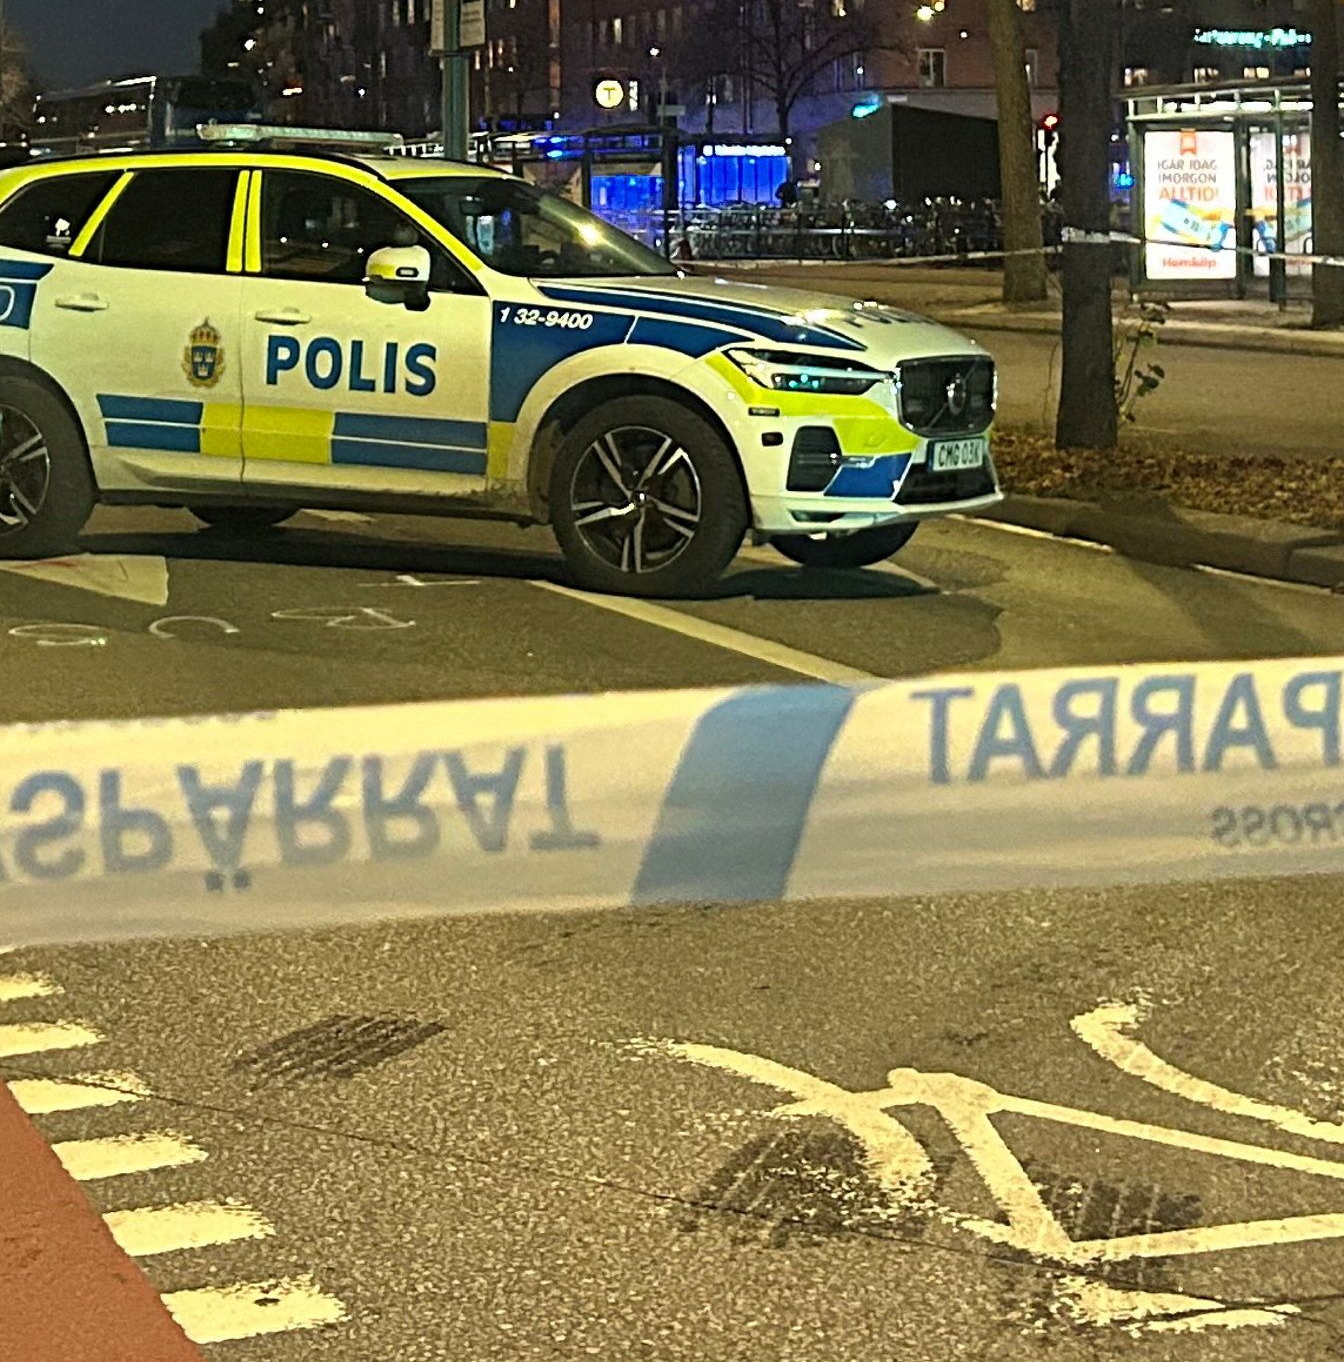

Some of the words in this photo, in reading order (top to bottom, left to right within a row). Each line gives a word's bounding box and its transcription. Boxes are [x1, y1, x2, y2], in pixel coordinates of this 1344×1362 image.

[602, 87, 616, 100] T
[500, 307, 511, 323] 1
[513, 308, 594, 330] 32-9400
[266, 335, 438, 397] POLIS
